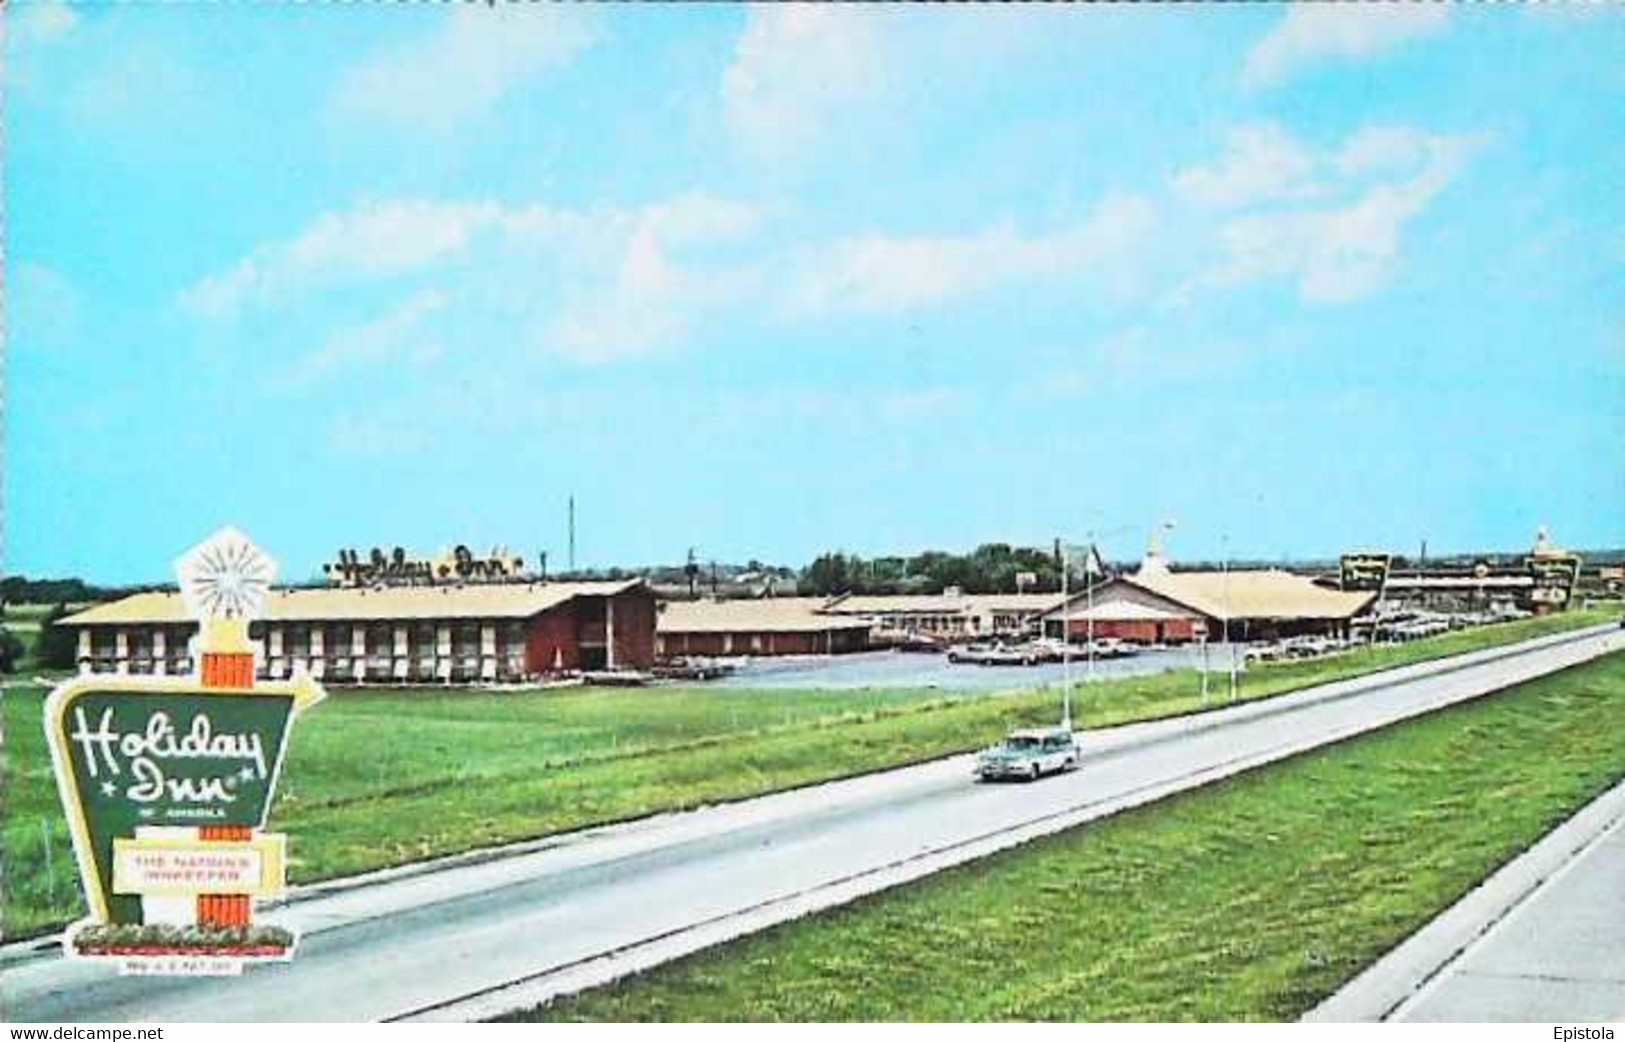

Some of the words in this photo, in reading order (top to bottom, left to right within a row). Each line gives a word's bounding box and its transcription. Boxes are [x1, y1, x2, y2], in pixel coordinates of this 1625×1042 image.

[335, 547, 435, 589] Holiday
[454, 545, 508, 576] Inn
[72, 706, 267, 779] Holiday
[126, 757, 236, 803] Inn
